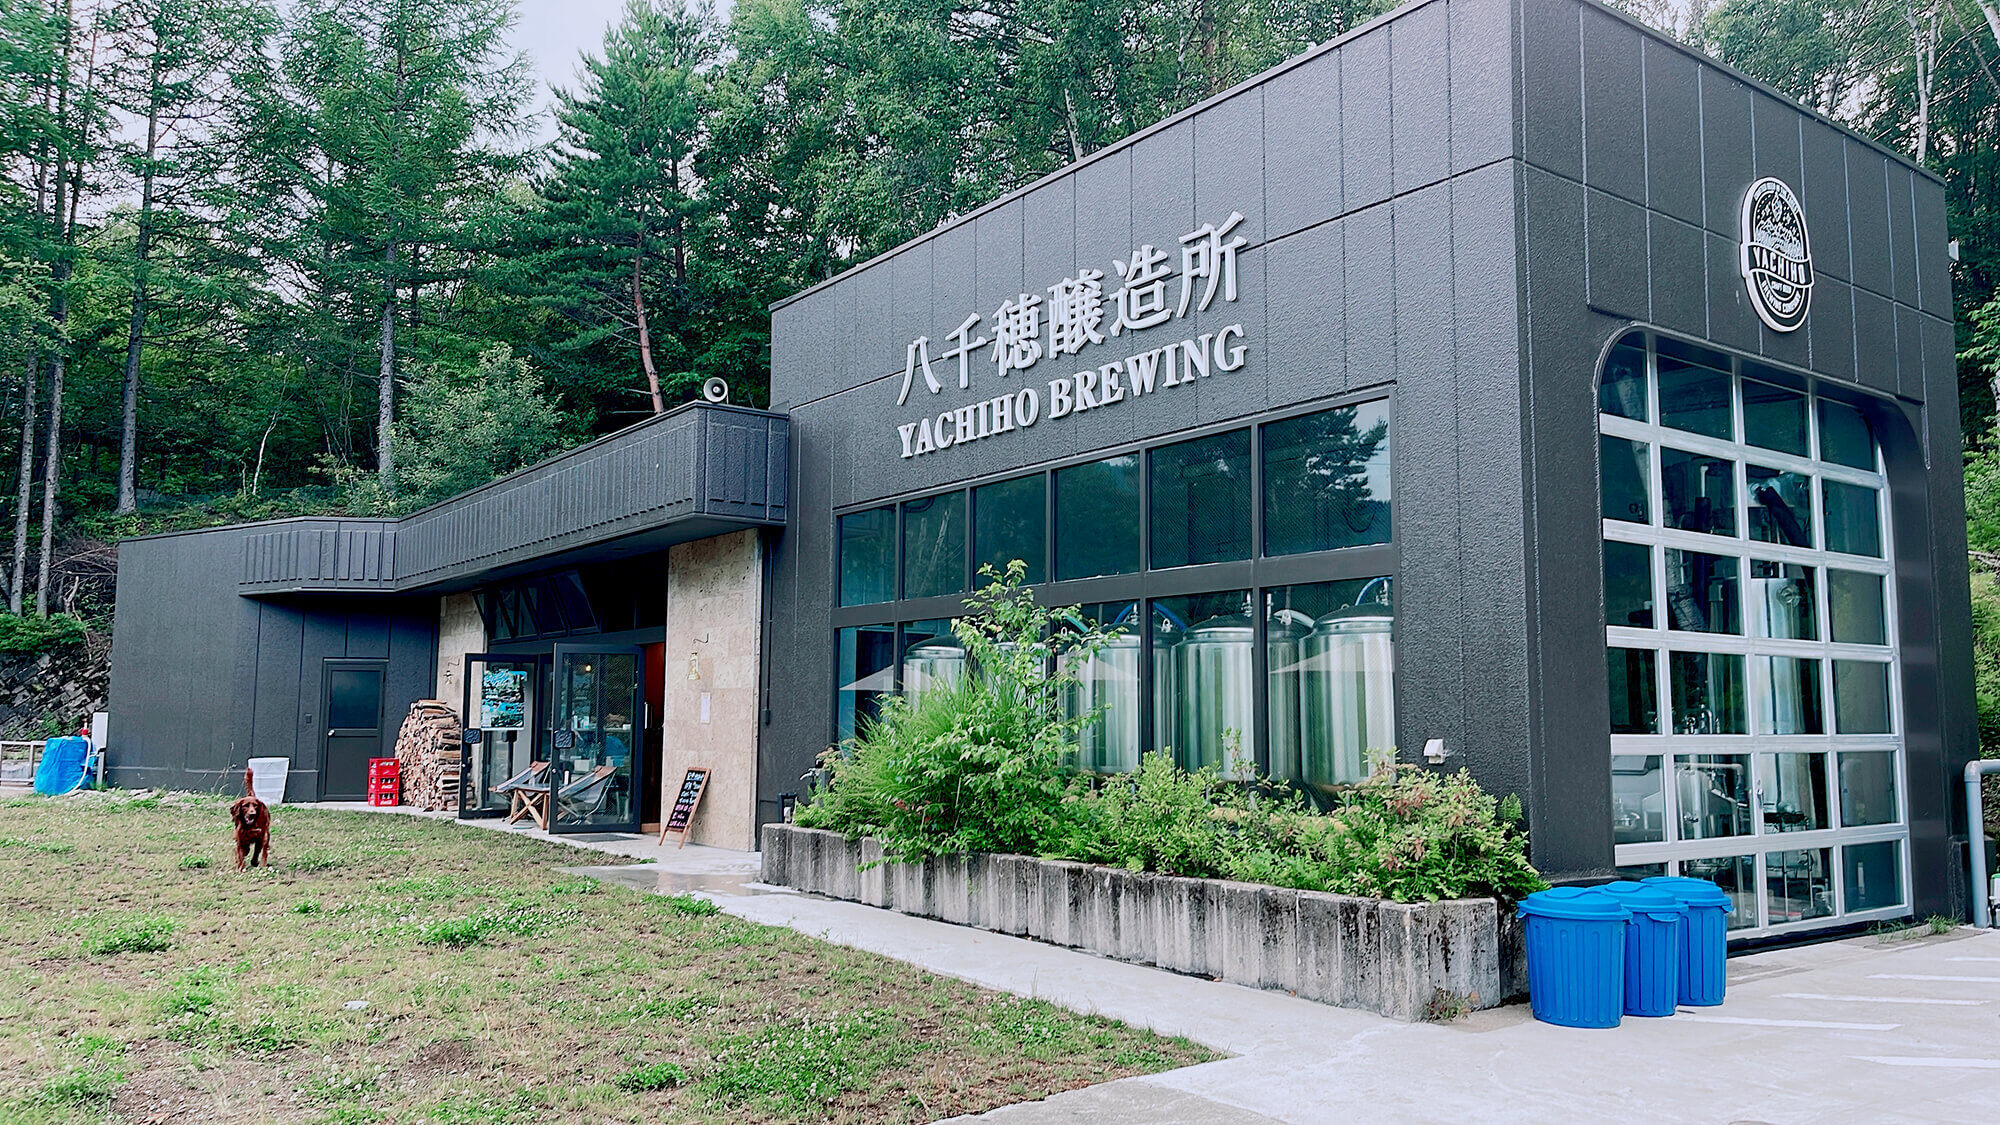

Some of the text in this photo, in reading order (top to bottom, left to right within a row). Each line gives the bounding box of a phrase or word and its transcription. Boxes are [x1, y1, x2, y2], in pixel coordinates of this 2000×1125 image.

[1752, 246, 1806, 285] YACHIHO
[897, 323, 1247, 458] YACHIHO BREWING
